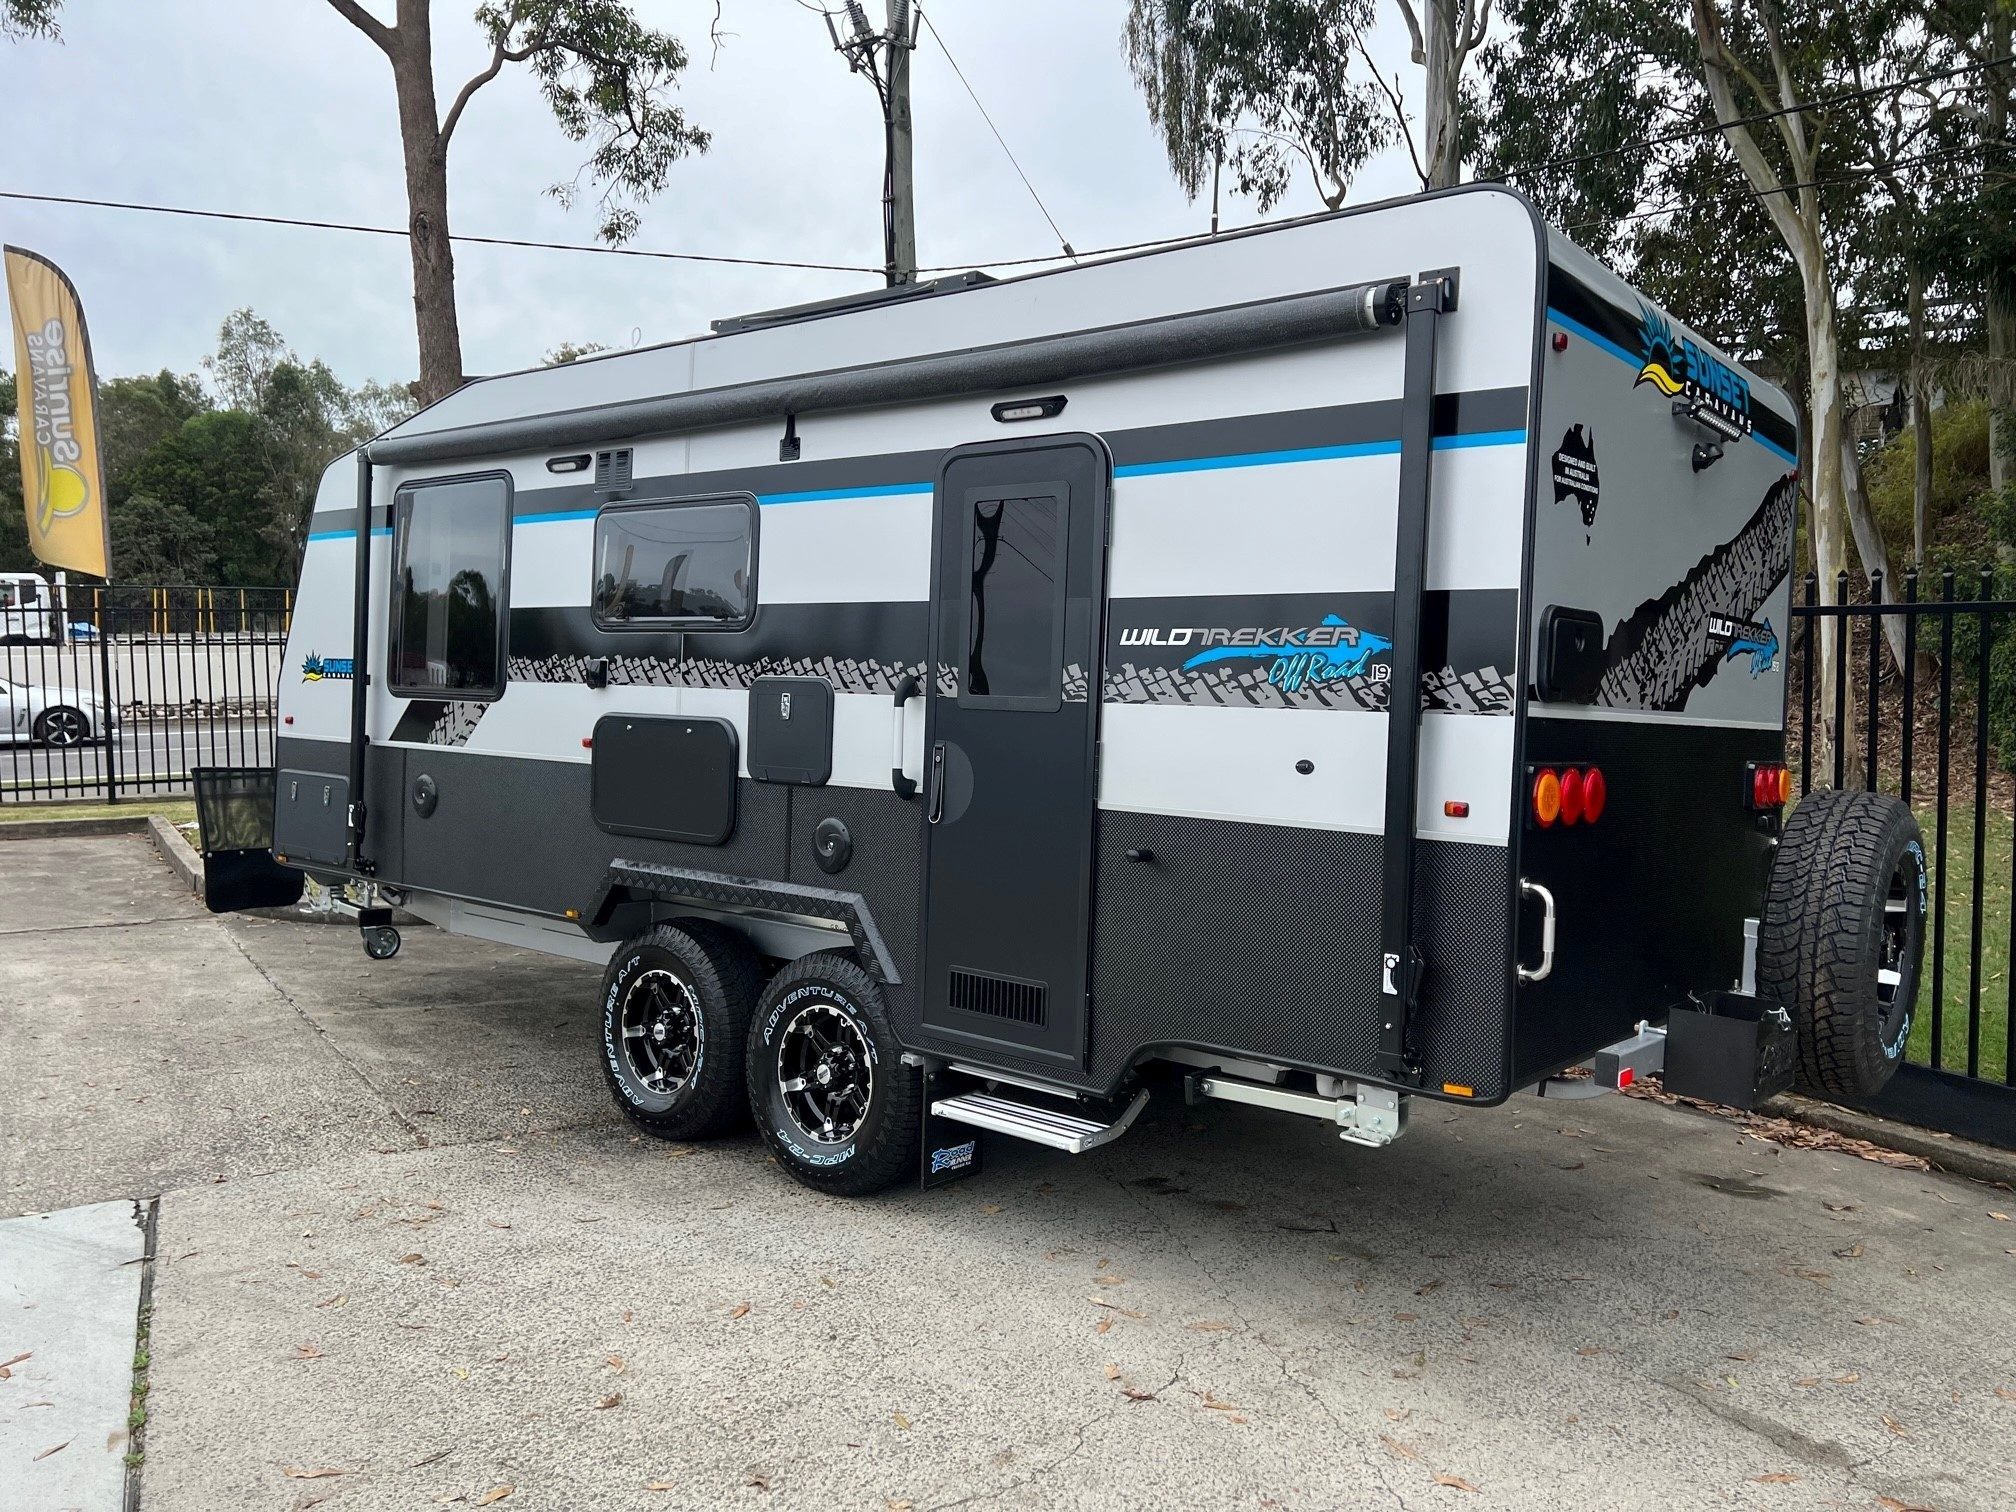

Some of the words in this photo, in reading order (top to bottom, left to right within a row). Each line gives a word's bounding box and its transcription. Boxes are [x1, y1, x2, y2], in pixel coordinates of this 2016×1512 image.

[1682, 338, 1750, 415] SUNSET
[1685, 381, 1752, 433] CARAVANS
[1577, 460, 1586, 469] AND
[1119, 627, 1360, 646] WILDTREKKER
[1709, 617, 1771, 643] WILDTREKKER
[323, 658, 353, 673] SUNSE
[1268, 653, 1310, 692] Off
[1305, 649, 1372, 682] Road
[618, 956, 640, 984] A/T
[605, 983, 644, 1105] ADVENTURE
[763, 986, 857, 1046] ADVENTURE
[856, 1019, 879, 1065] A/T
[776, 1128, 856, 1165] MPC-24
